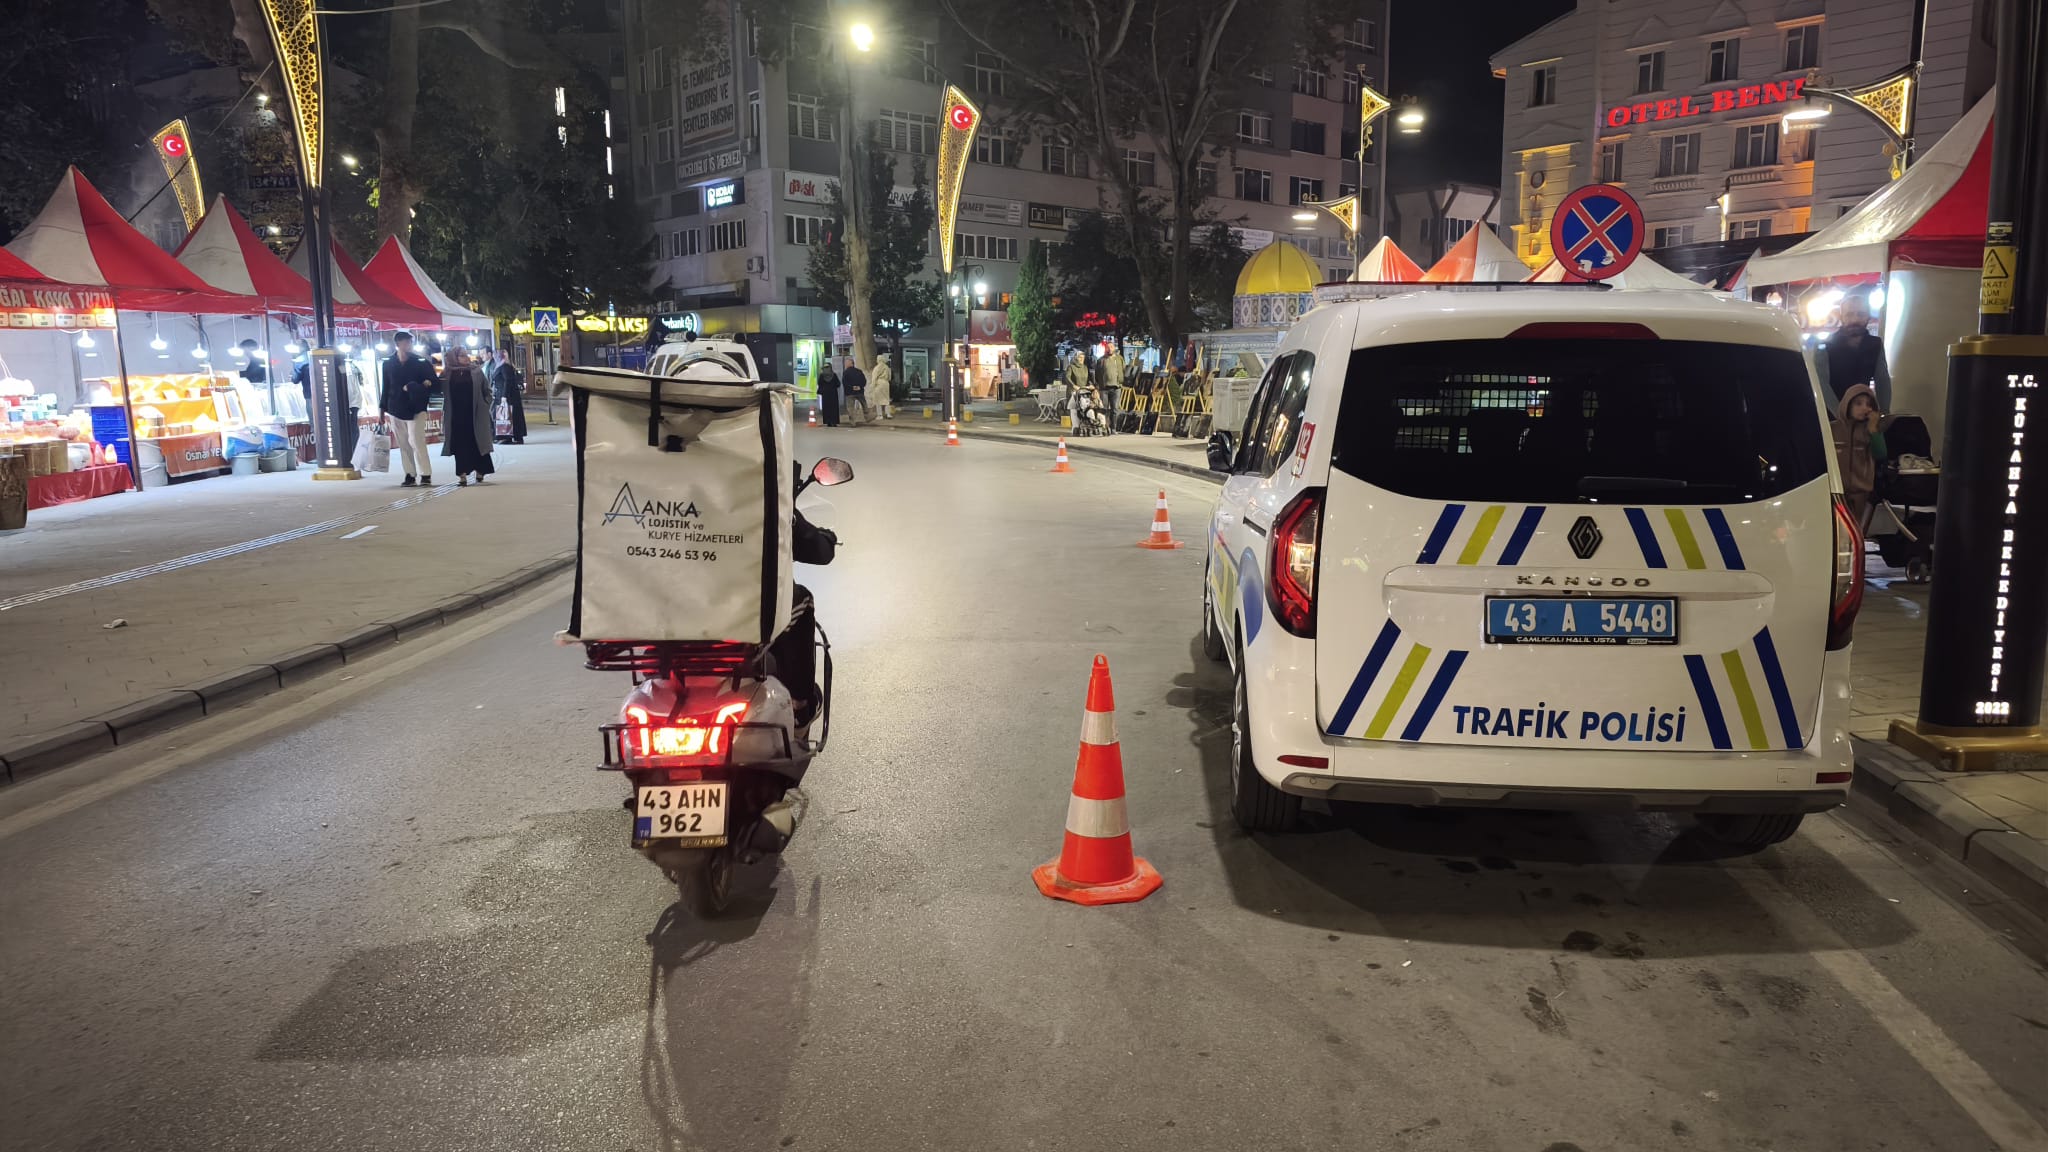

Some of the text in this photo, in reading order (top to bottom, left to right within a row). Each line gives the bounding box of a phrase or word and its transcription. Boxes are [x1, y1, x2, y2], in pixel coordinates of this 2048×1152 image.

[1607, 97, 1700, 128] OTEL
[33, 289, 75, 309] KAYA
[76, 290, 113, 310] TUZU
[2007, 375, 2038, 388] T.C.
[2004, 397, 2027, 514] KÜTAHYA
[642, 500, 698, 518] ANKA
[693, 522, 704, 530] ve
[648, 530, 744, 544] KURYE HİZMETLERİ
[627, 545, 717, 561] 0543 246 53 96
[1517, 575, 1651, 587] KANGOO
[1505, 603, 1667, 632] 43 A 5448
[1990, 529, 2015, 693] BELEDİYESİ
[1975, 702, 2010, 715] 2022
[1453, 701, 1686, 743] TRAFİK POLİSİ
[643, 788, 720, 810] 43 AHN
[660, 813, 702, 834] 962
